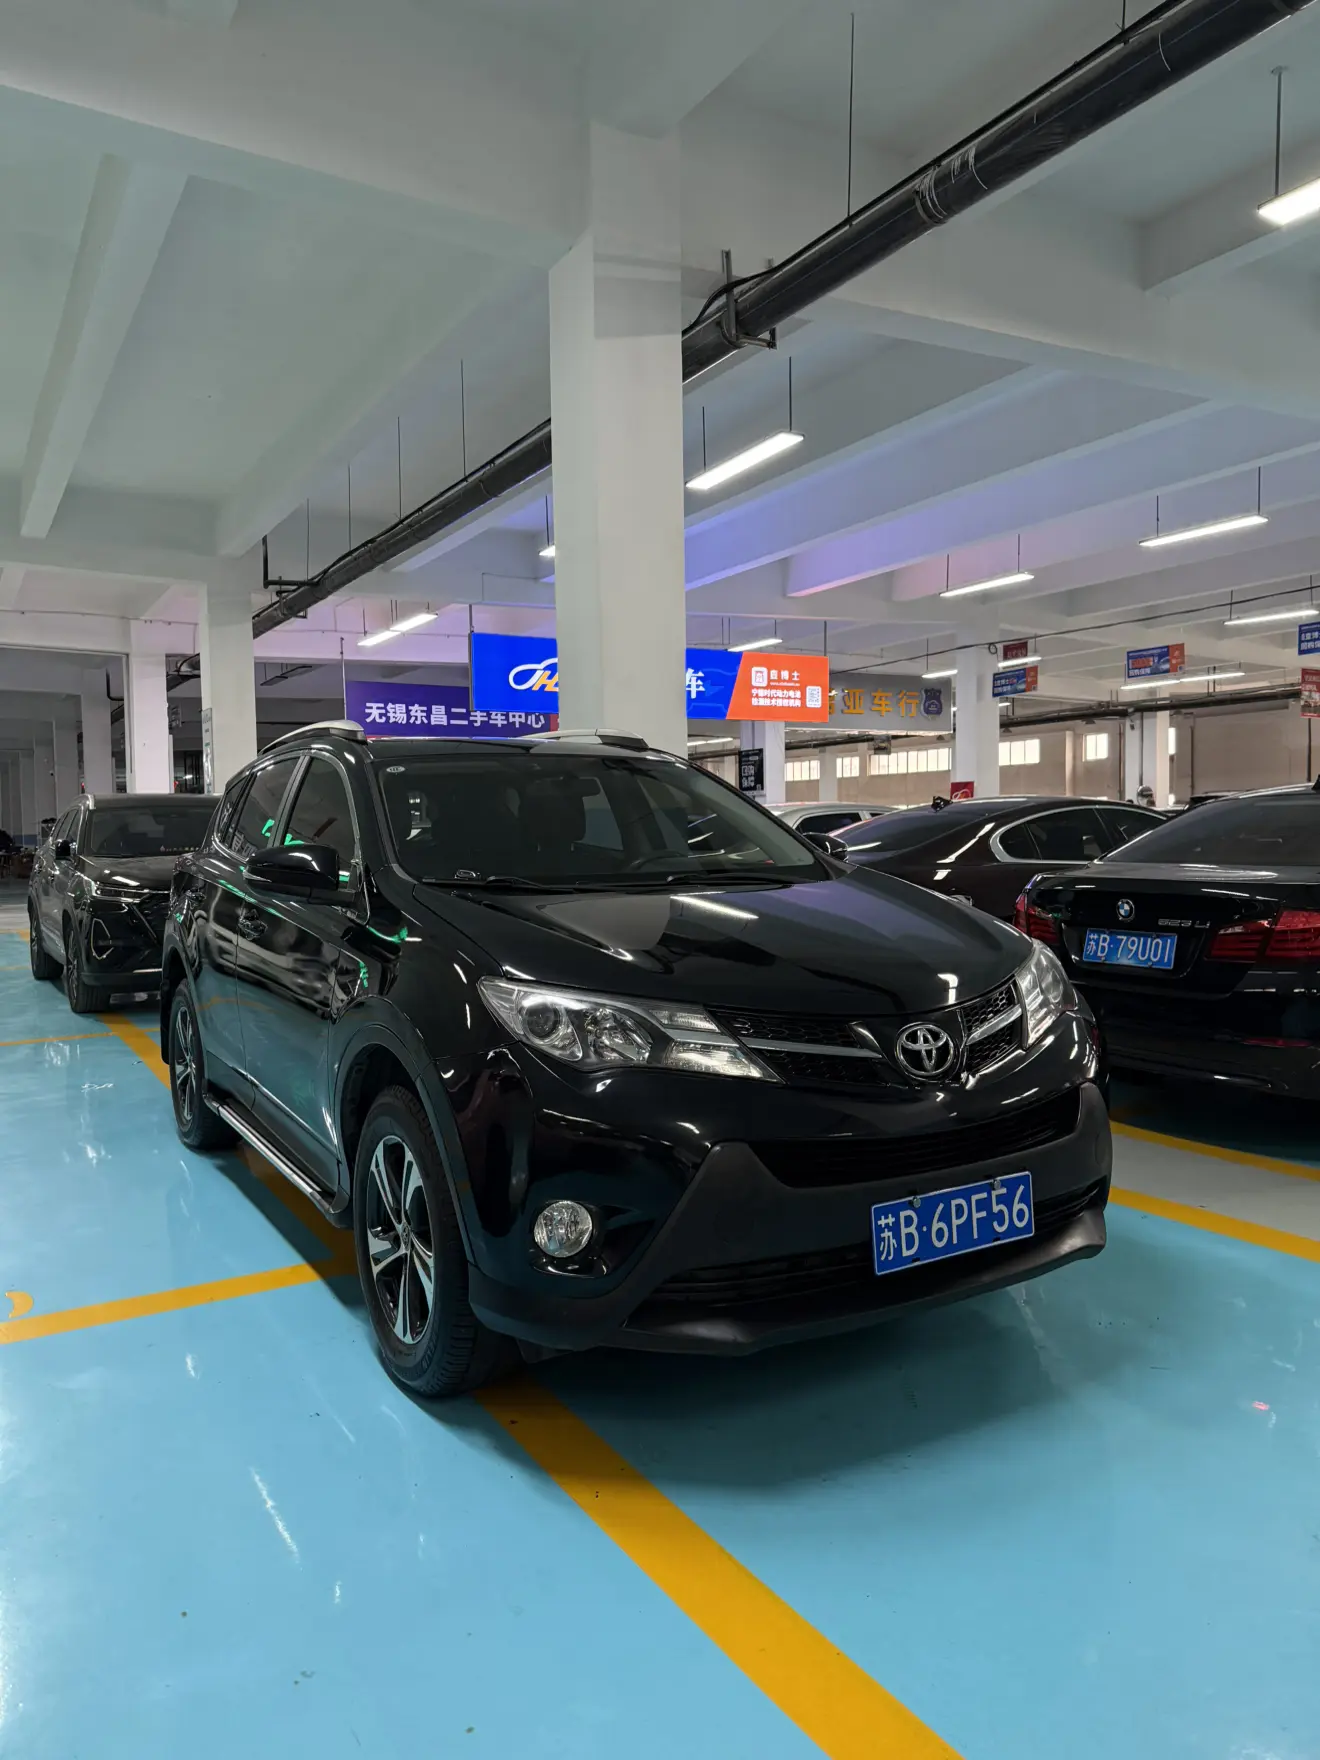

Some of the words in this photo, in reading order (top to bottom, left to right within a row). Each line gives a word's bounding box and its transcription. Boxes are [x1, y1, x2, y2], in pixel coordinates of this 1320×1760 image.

[364, 702, 546, 728] 无锡东昌二手车中心
[877, 1184, 1030, 1261] 苏B·6PF56
